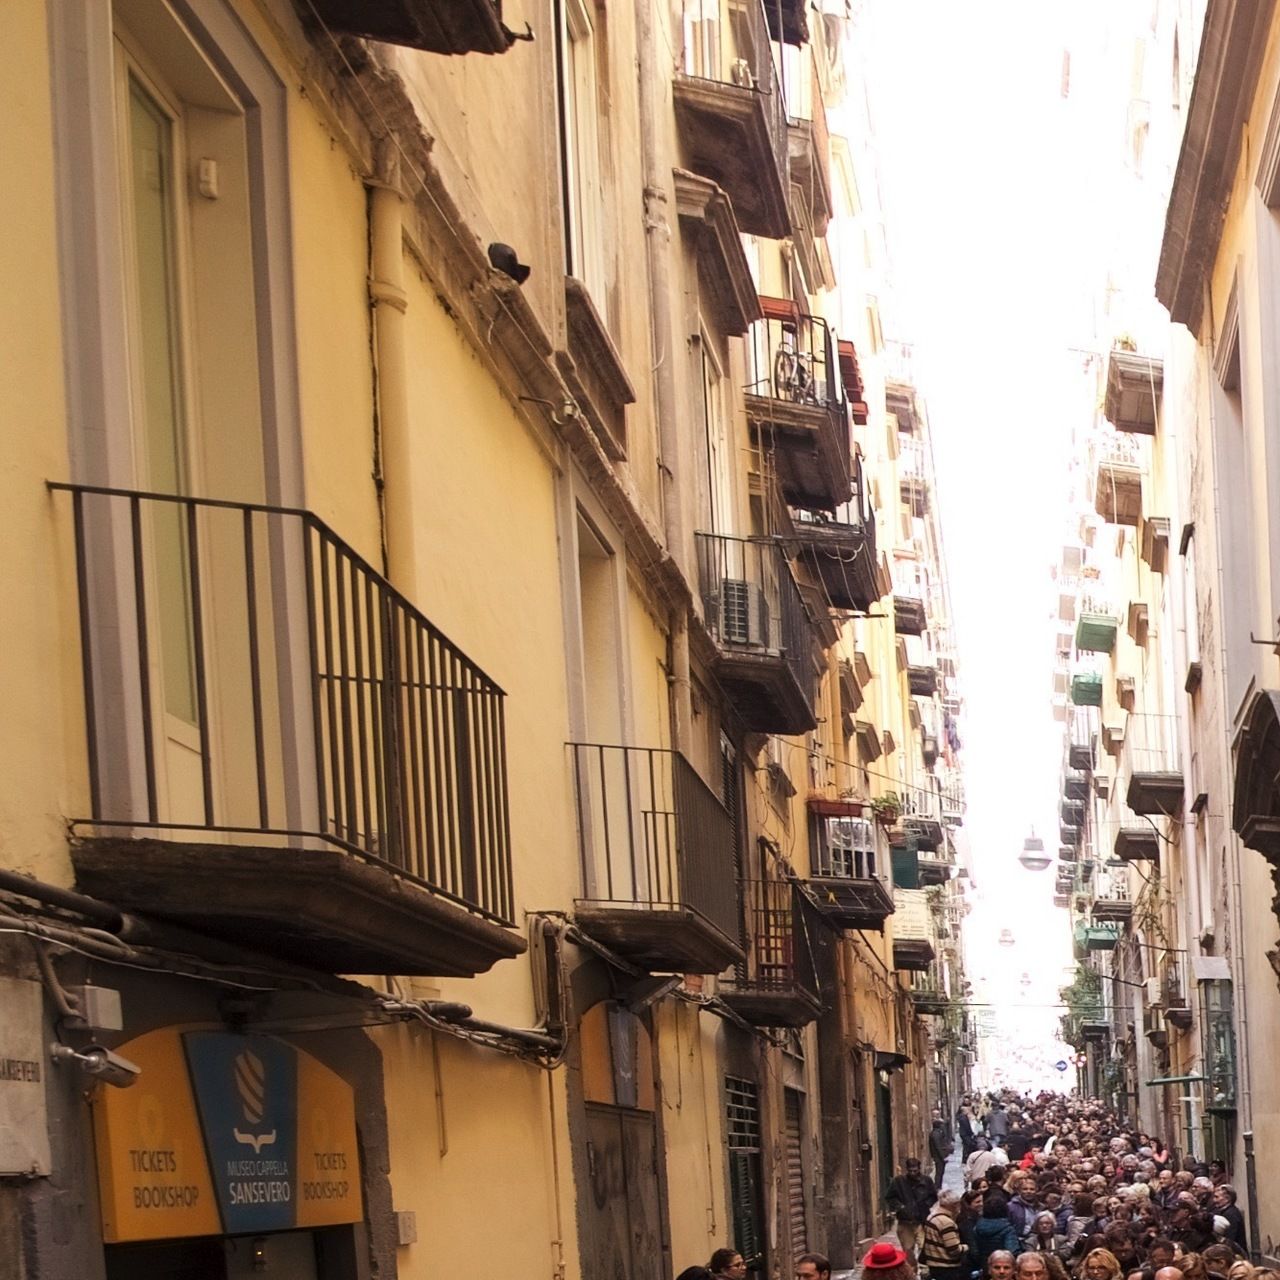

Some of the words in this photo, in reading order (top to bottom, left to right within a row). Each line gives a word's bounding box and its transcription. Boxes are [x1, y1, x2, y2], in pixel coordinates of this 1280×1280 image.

[130, 1149, 176, 1173] TICKETS
[227, 1161, 256, 1176] MUSEO
[257, 1161, 288, 1176] CAPPELLA
[314, 1152, 347, 1171] TICKETS
[133, 1185, 199, 1209] BOOKSHOP
[229, 1181, 290, 1205] SANSEVERO
[303, 1181, 349, 1201] BOOKSHOP
